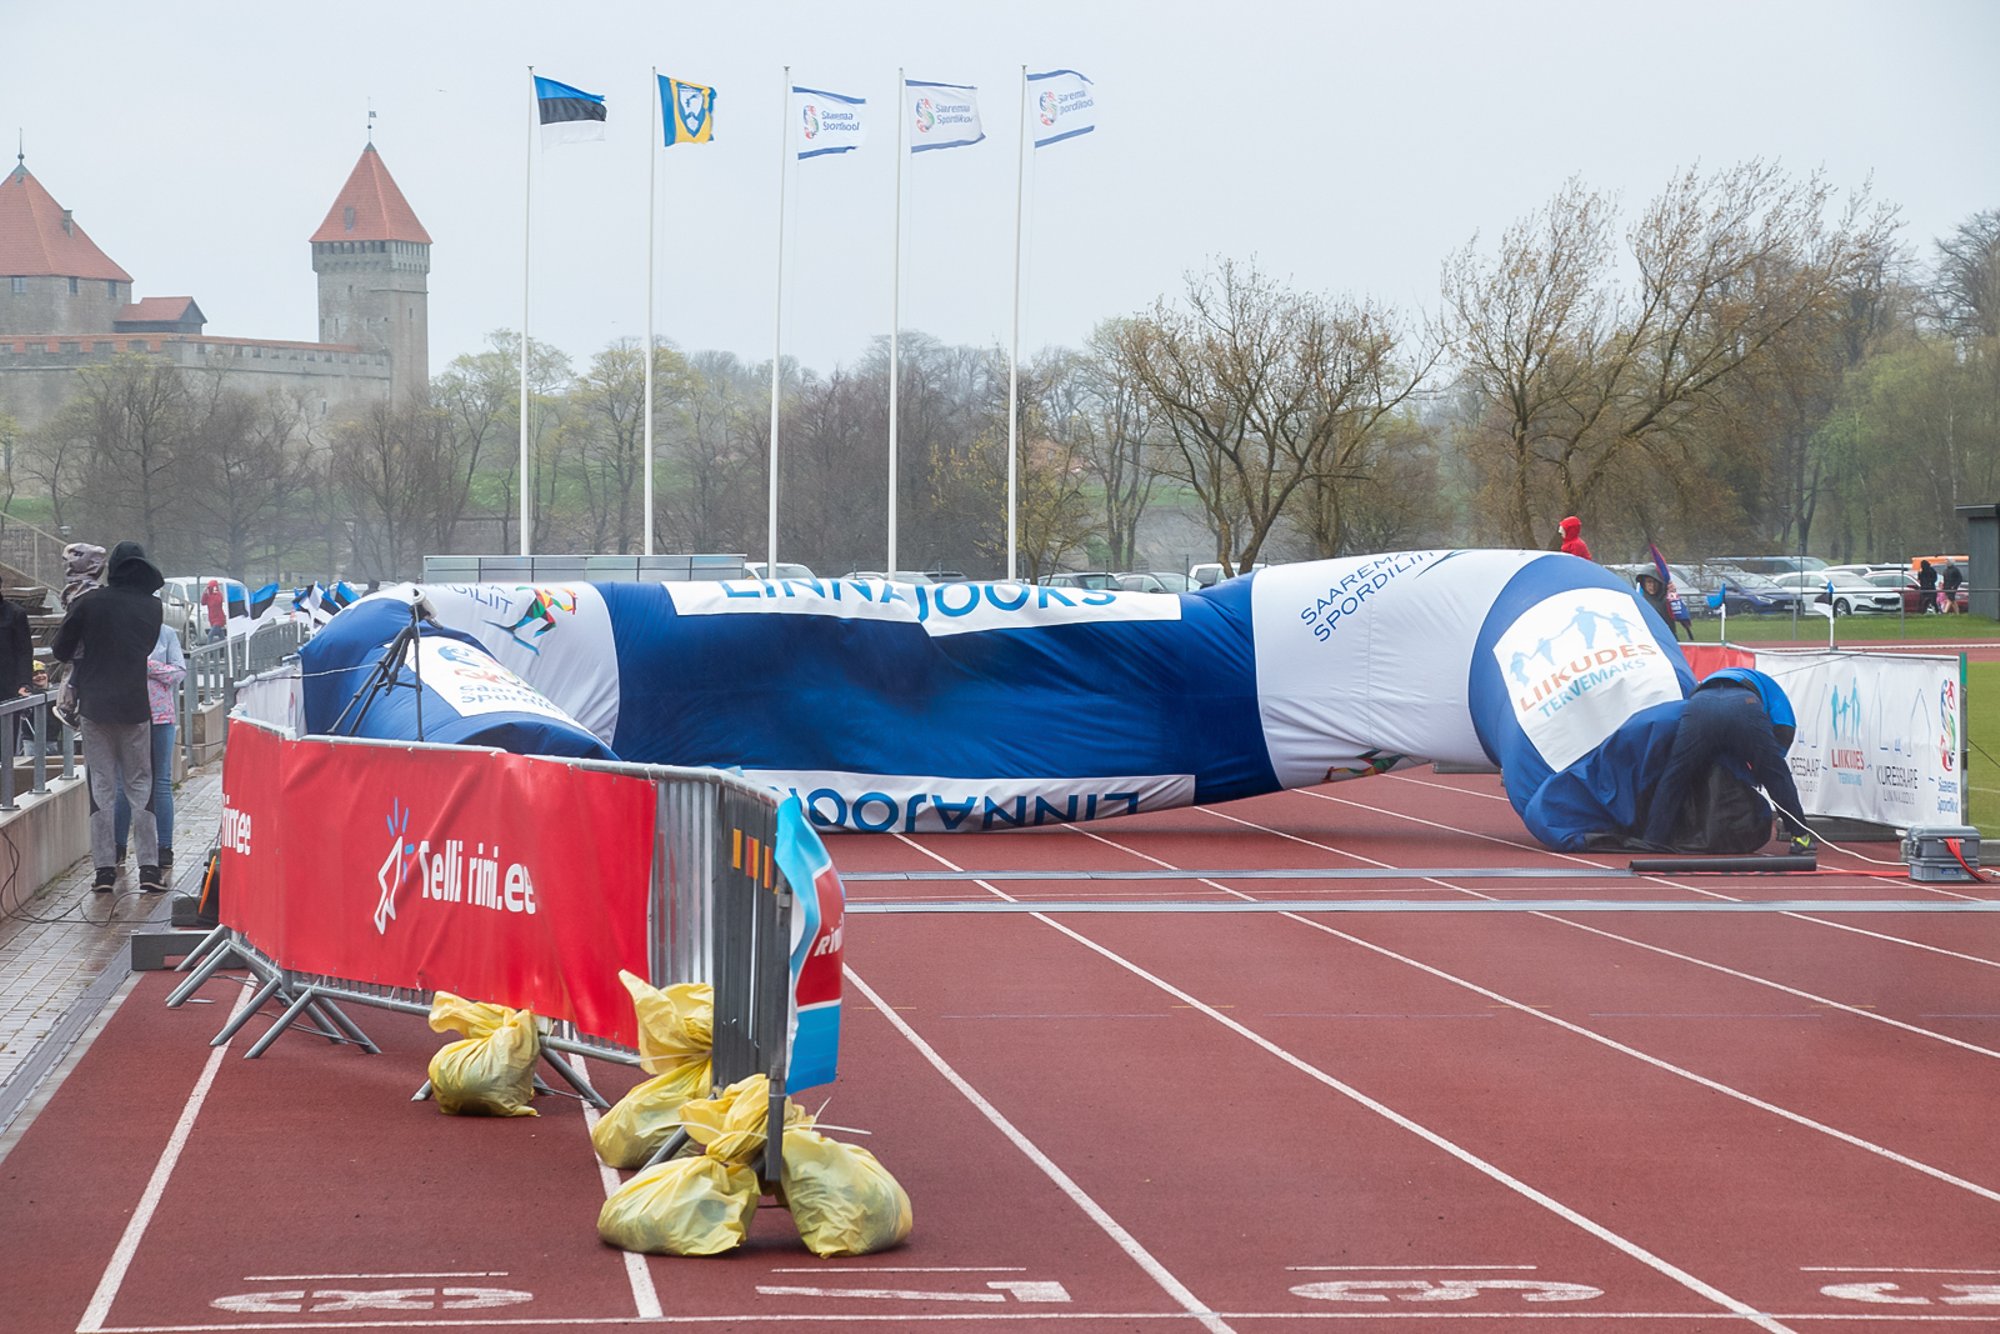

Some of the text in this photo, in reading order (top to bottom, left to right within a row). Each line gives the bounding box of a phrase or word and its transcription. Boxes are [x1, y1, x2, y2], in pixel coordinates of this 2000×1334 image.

[1520, 644, 1657, 712] LIIKUDES
[1538, 659, 1646, 718] TERVEMAKS
[419, 839, 536, 914] Telli rimi.ee
[755, 1281, 1073, 1302] 7
